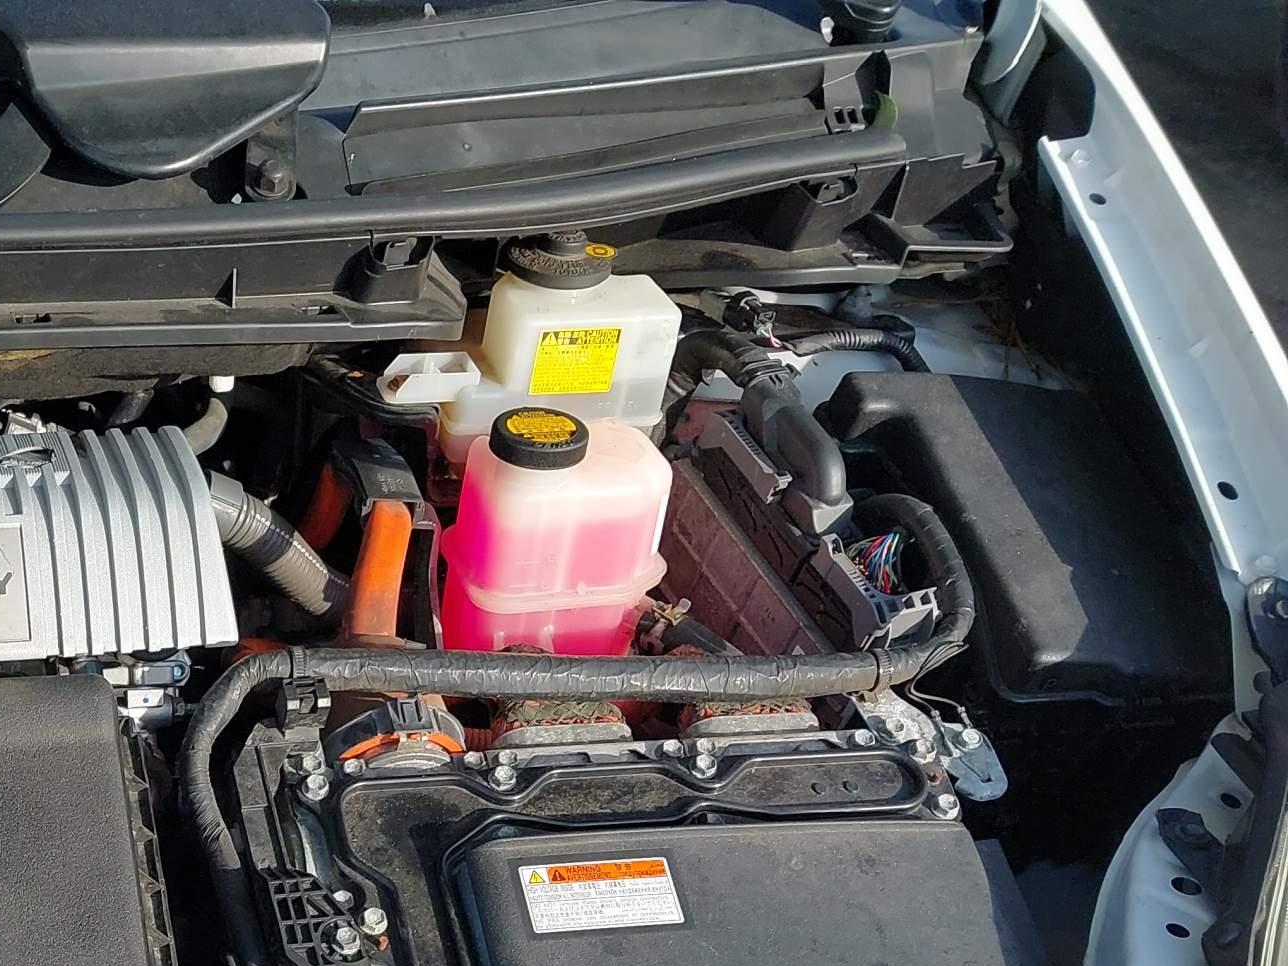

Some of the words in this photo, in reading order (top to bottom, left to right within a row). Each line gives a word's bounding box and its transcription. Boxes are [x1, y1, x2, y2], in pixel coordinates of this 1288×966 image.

[586, 330, 619, 338] CAUTION
[565, 864, 600, 874] WARNING
[567, 872, 612, 881] AVERTISSEMENT
